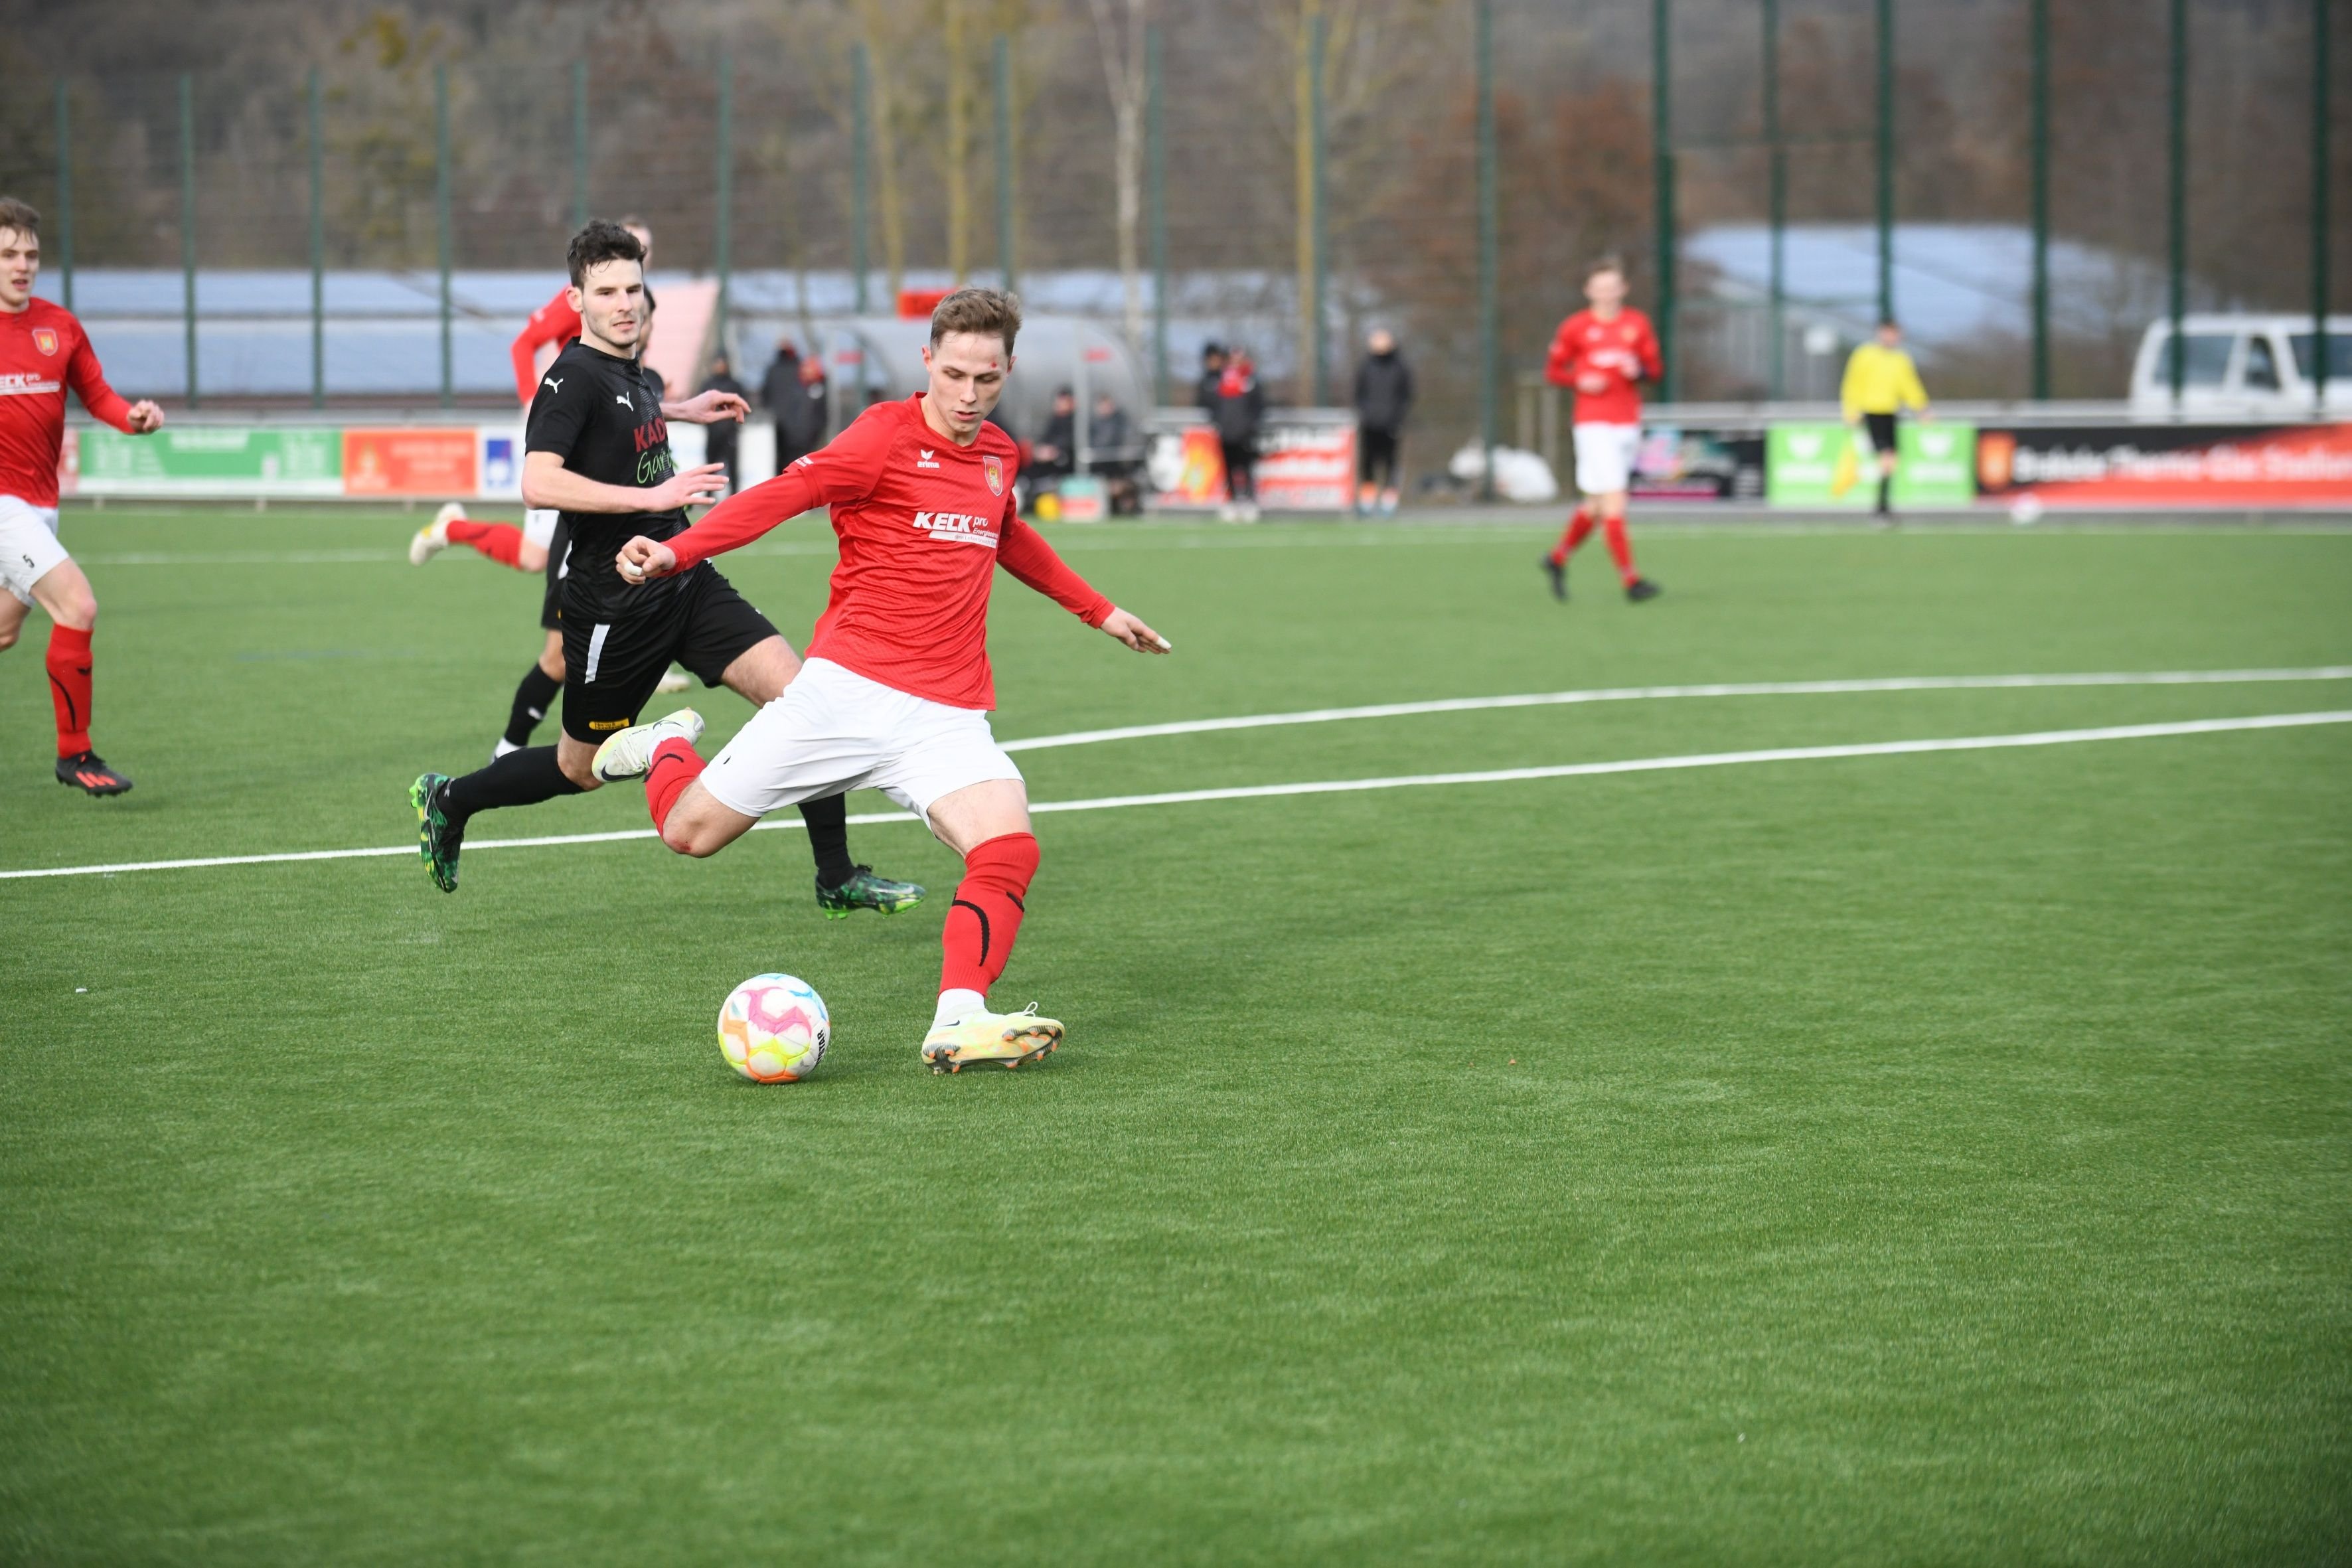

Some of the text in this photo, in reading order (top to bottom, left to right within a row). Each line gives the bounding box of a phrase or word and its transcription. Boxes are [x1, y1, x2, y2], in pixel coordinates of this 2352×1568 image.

[913, 511, 988, 533] KECK pro
[23, 554, 35, 568] 5
